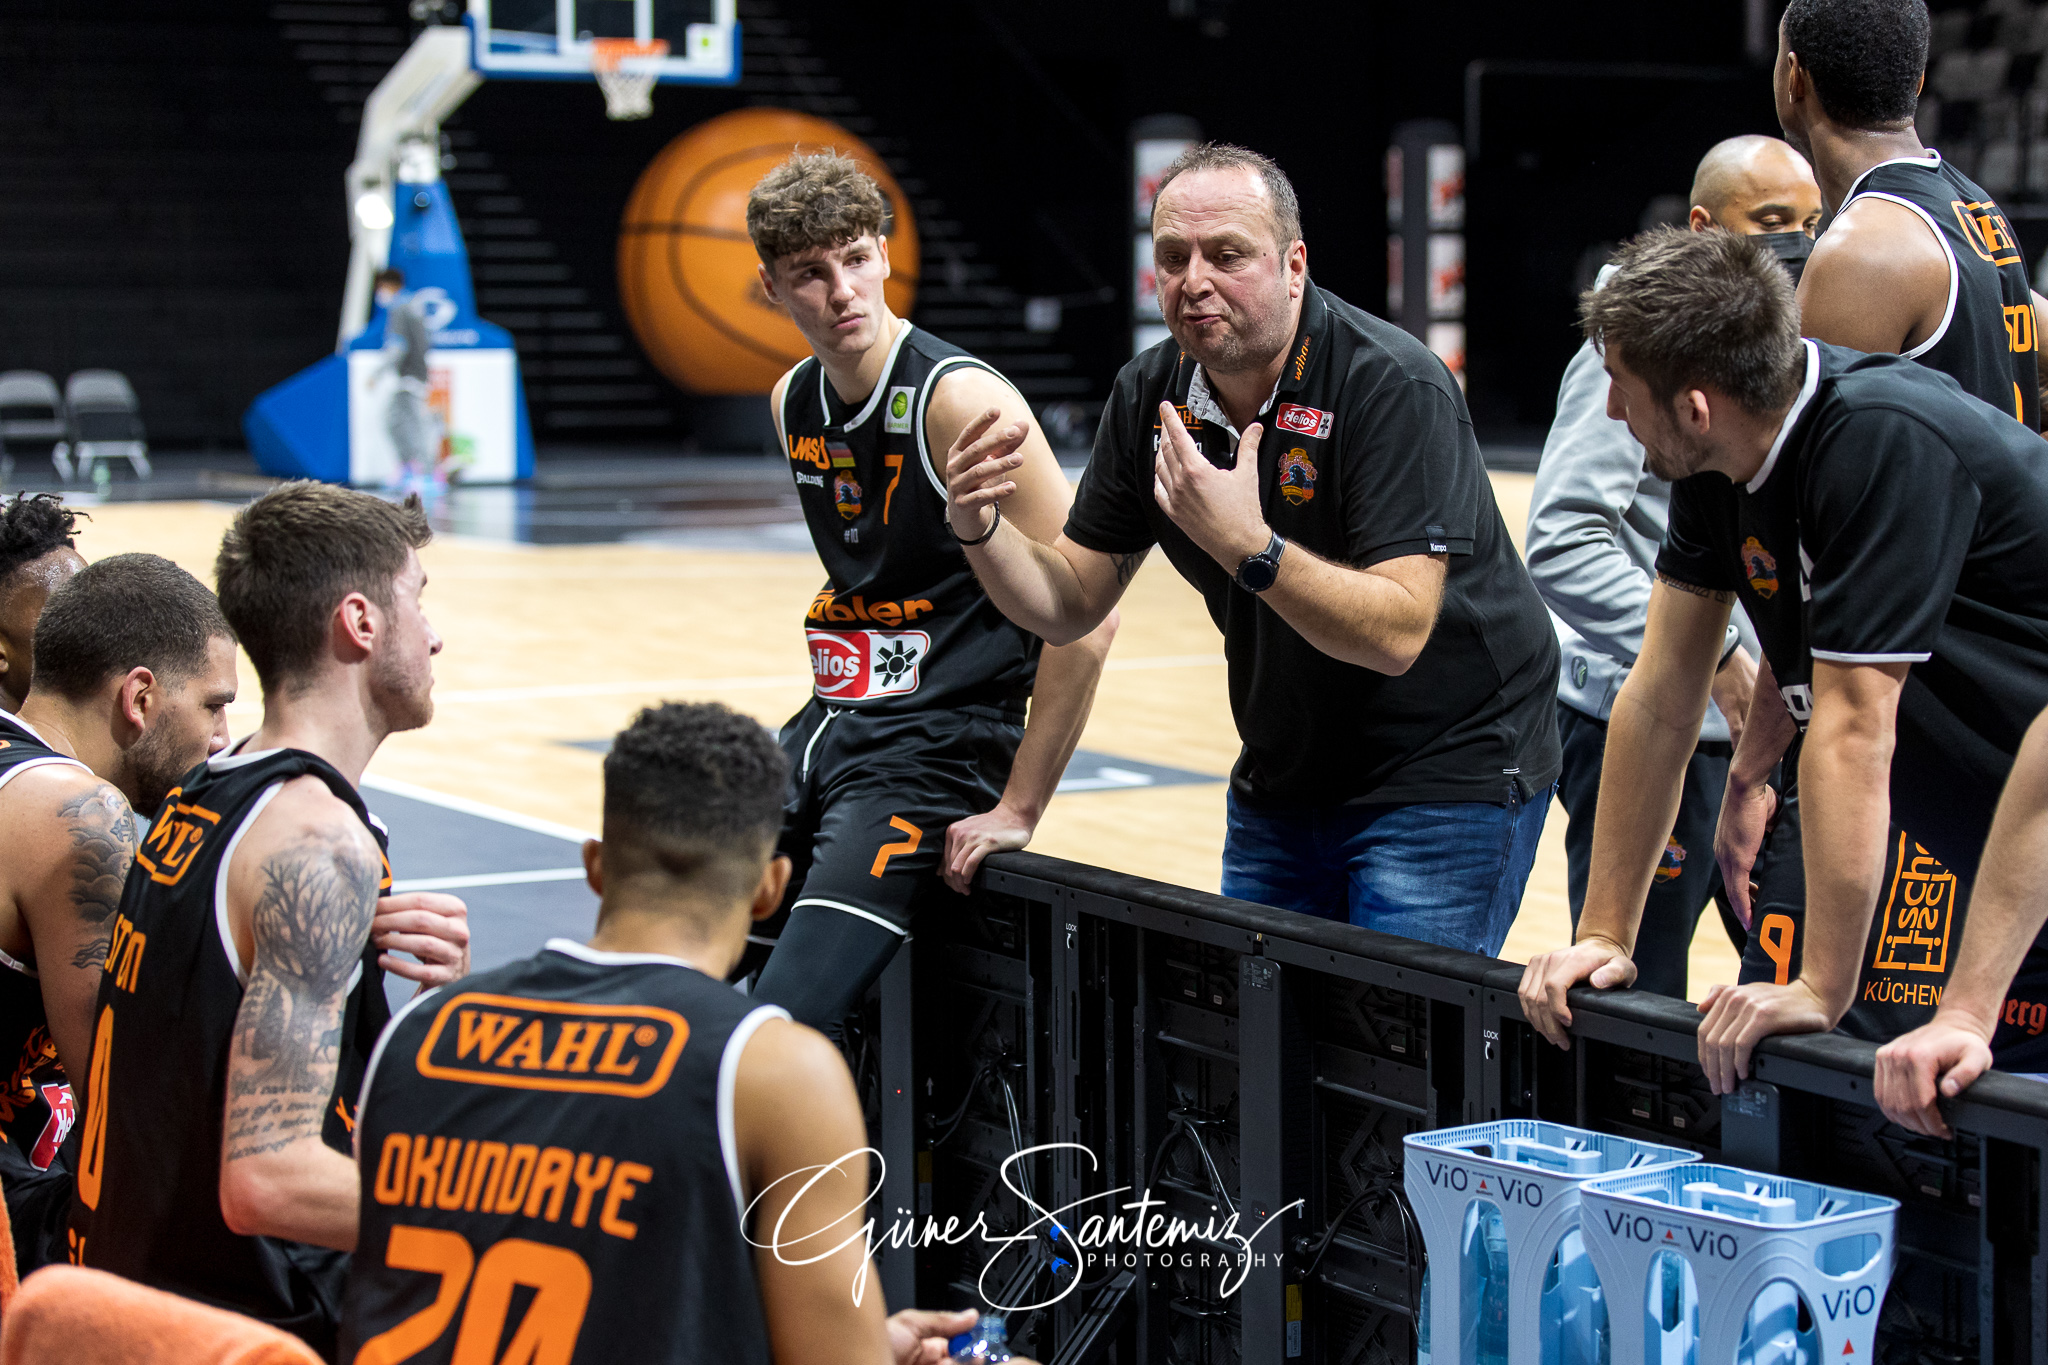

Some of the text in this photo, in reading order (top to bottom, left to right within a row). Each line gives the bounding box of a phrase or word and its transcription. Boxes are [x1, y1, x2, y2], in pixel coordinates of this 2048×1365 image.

[1283, 410, 1317, 428] Helios
[796, 471, 824, 488] SPALDING
[883, 454, 904, 525] 7
[811, 648, 861, 677] elios
[870, 815, 923, 878] 7
[1066, 923, 1078, 932] LOCK
[1759, 914, 1795, 986] 9
[1864, 977, 1942, 1006] KÜCHEN
[1483, 1029, 1499, 1041] LOCK
[374, 1131, 654, 1240] OKUNDAYE
[1425, 1160, 1469, 1192] ViO
[1498, 1176, 1543, 1208] ViO
[1604, 1209, 1654, 1243] ViO
[1686, 1226, 1739, 1261] ViO
[352, 1223, 593, 1365] 20
[1821, 1284, 1875, 1321] ViO
